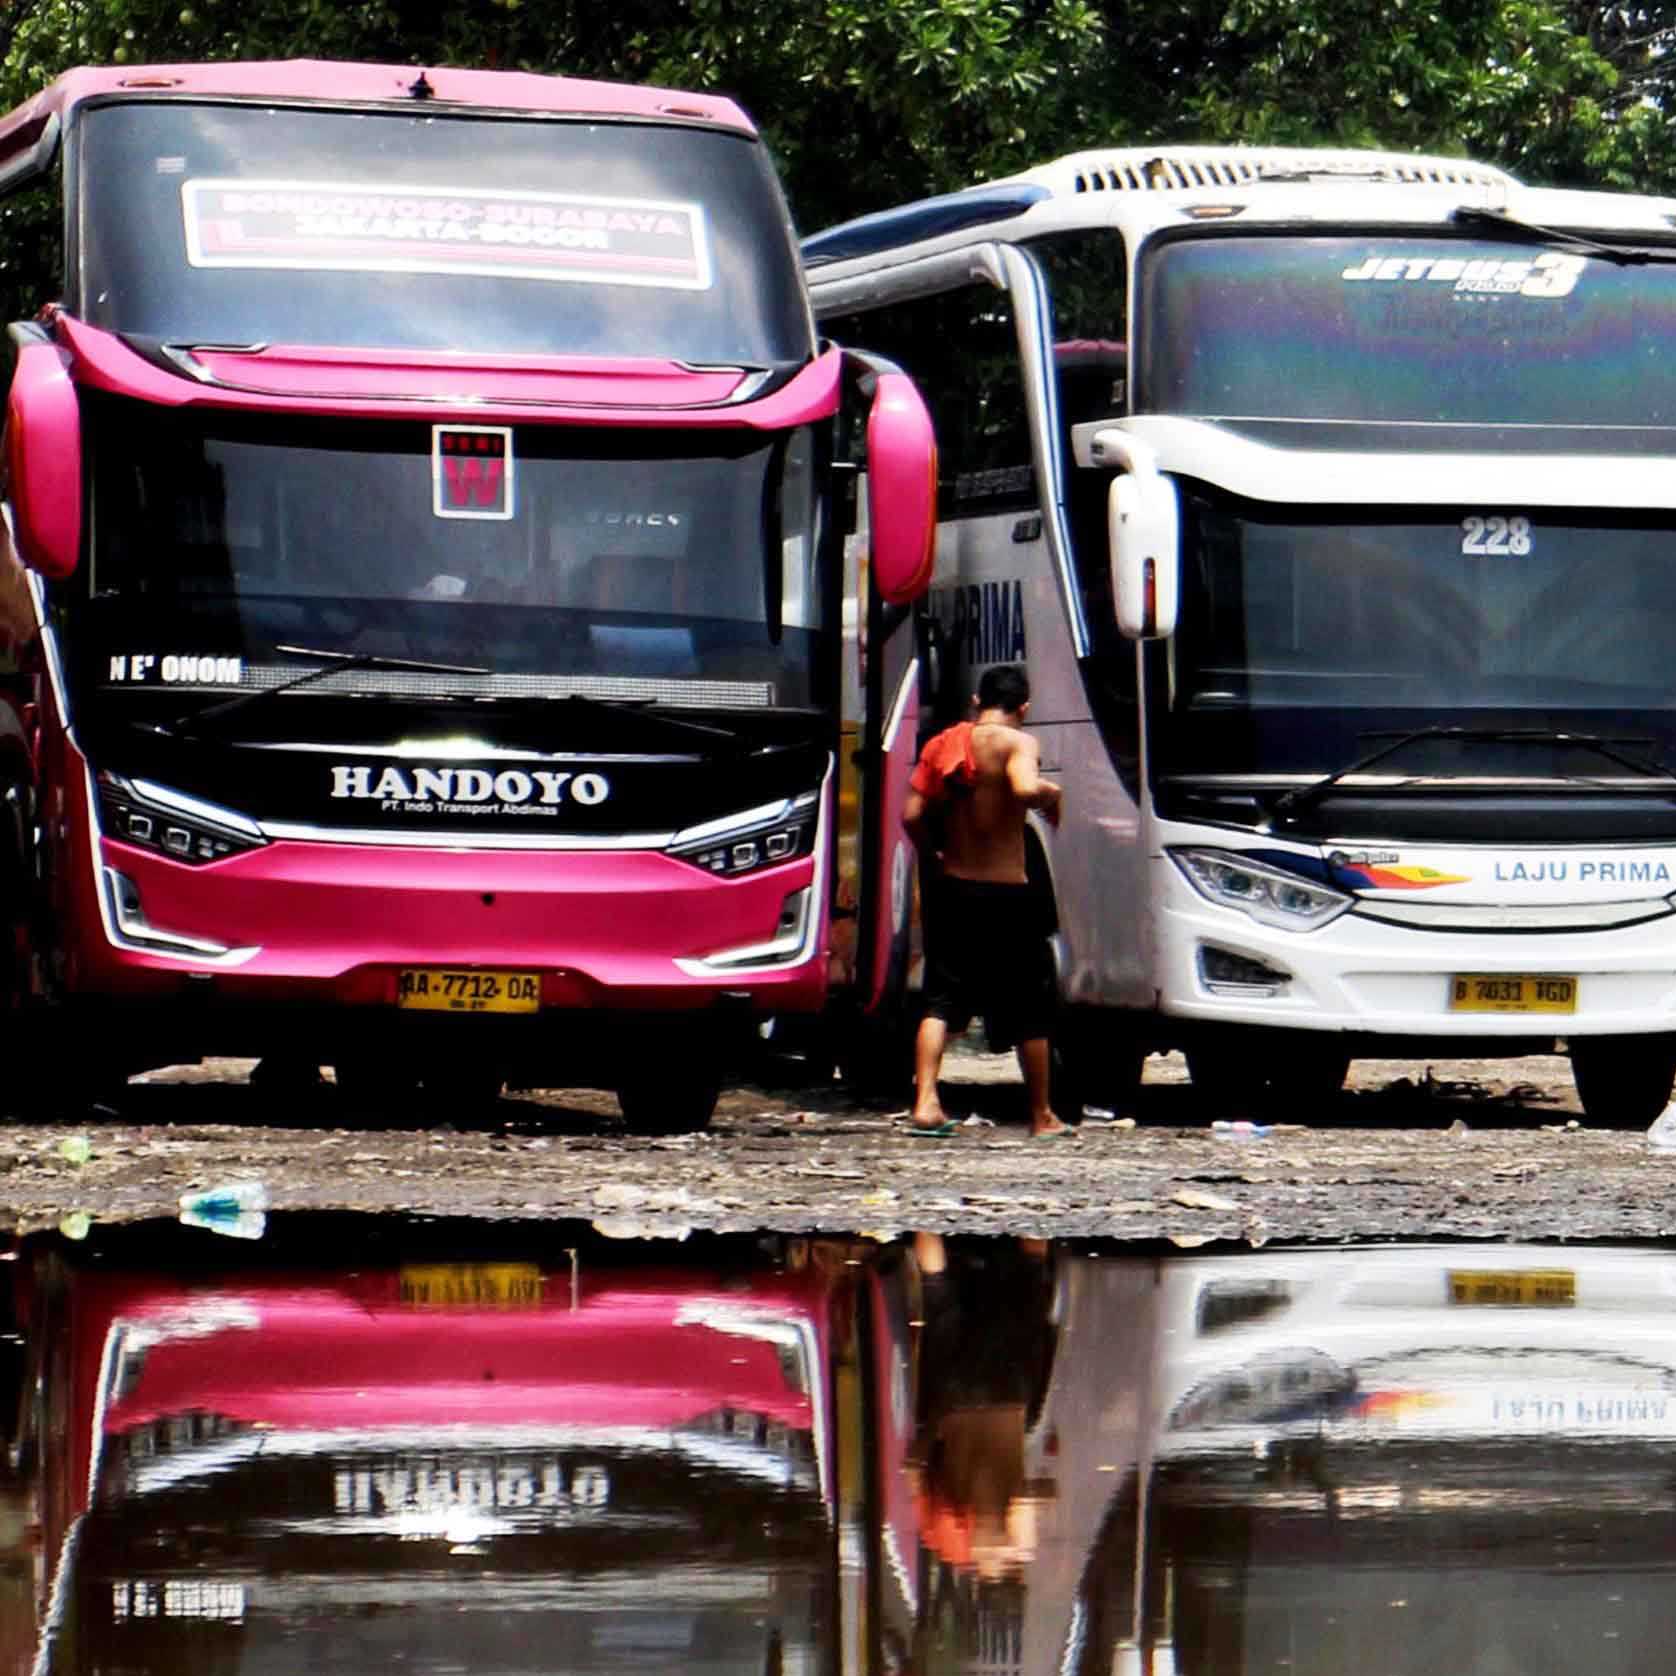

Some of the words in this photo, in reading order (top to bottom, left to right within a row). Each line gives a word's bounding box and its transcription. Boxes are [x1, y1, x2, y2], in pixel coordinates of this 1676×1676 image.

[1462, 516, 1531, 556] 228
[161, 654, 241, 684] ONOM
[331, 766, 609, 806] HANDOYO
[403, 801, 434, 813] Indo
[436, 801, 499, 816] Transport
[501, 803, 559, 816] Abdimas
[1494, 862, 1568, 881] LAJU
[1579, 862, 1671, 881] PRIMA
[441, 974, 497, 998] 7712
